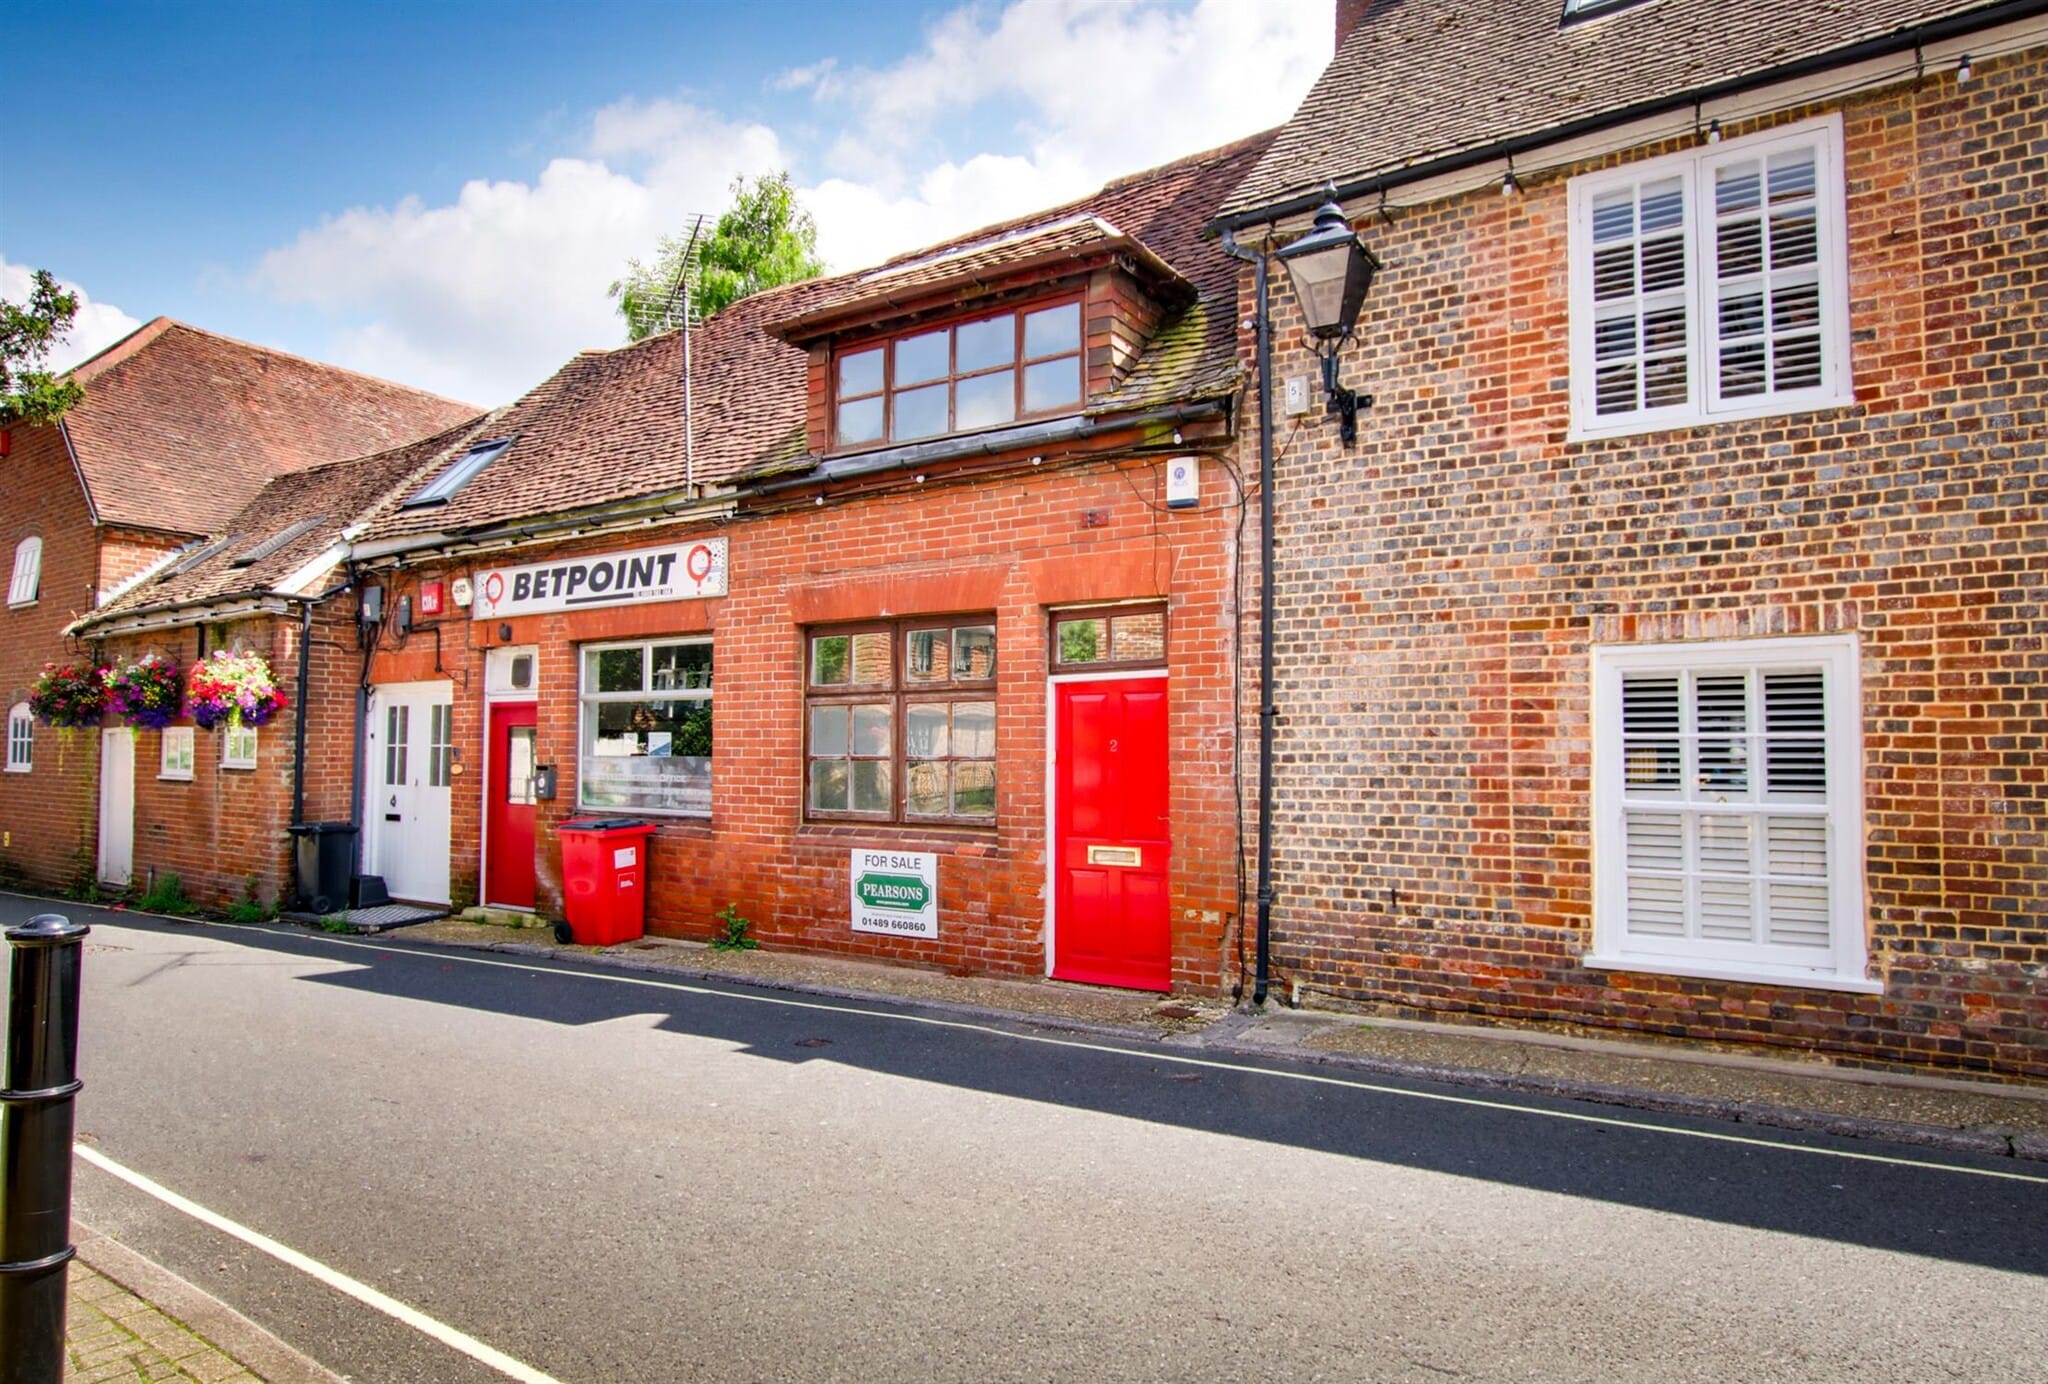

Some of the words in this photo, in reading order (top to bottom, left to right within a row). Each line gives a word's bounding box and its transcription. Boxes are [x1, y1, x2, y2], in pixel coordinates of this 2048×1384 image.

[512, 552, 677, 602] BETPOINT
[1109, 739, 1118, 752] 2
[865, 854, 888, 868] FOR
[891, 856, 921, 870] SALE
[863, 883, 923, 901] PEARSONS
[862, 916, 889, 928] 01489
[891, 920, 926, 932] 660860
